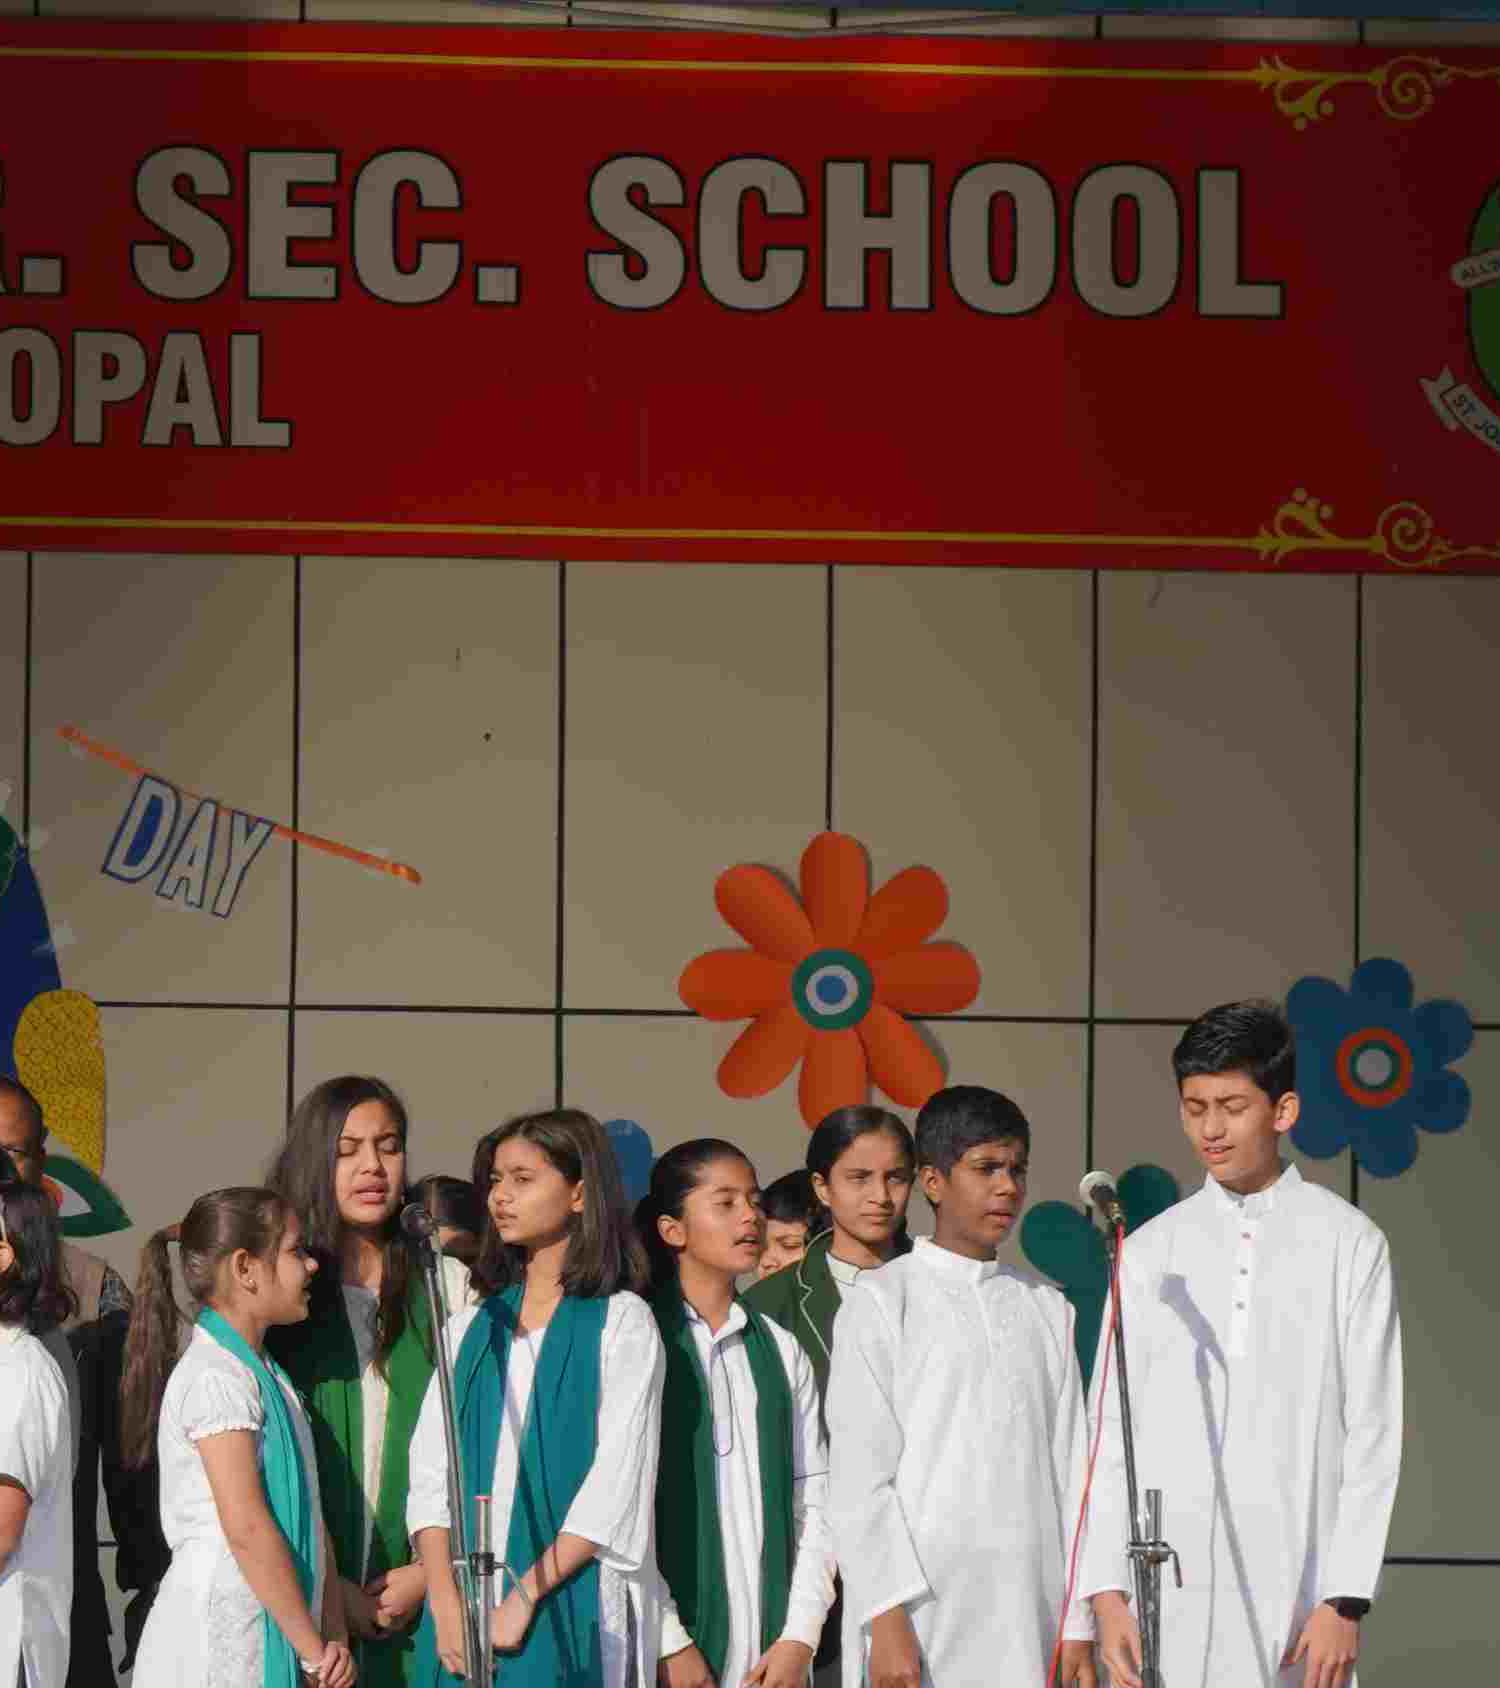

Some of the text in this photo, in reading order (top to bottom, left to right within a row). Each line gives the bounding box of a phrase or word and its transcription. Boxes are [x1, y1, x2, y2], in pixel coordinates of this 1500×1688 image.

[131, 145, 522, 310] SEC.
[584, 153, 1286, 319] SCHOOL
[101, 774, 275, 919] DAY
